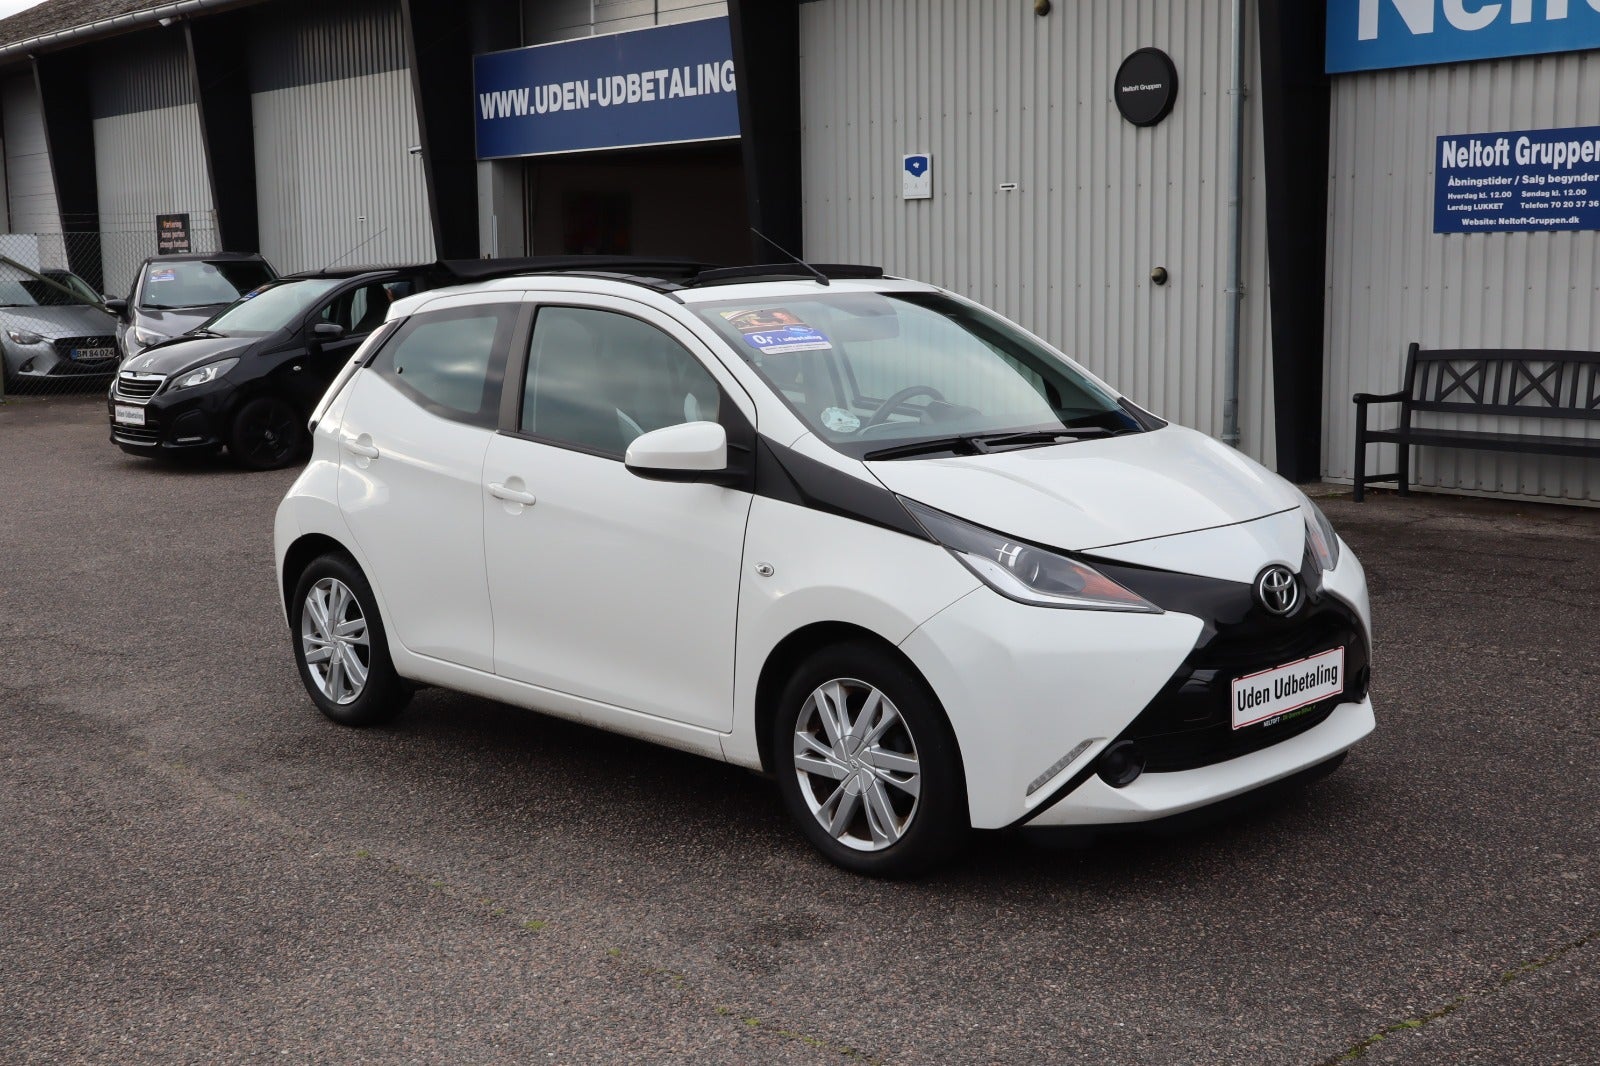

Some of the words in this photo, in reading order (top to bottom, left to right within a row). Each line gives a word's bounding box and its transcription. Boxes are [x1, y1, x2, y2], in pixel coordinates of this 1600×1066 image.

[1442, 138, 1510, 168] Neltoft
[1447, 175, 1513, 187] Åbningstider
[1522, 174, 1545, 185] Salg
[1548, 172, 1600, 185] begynder
[1447, 192, 1478, 200] Hverdag
[1521, 189, 1550, 197] Søndag
[1563, 188, 1587, 196] 12.00
[1473, 202, 1504, 210] LUKKET
[1575, 200, 1587, 208] 37
[1461, 217, 1497, 226] Website:
[1498, 216, 1580, 226] Neltoft-Gruppen.dk
[1237, 686, 1270, 711] Uden
[1274, 664, 1338, 699] Udbetaling
